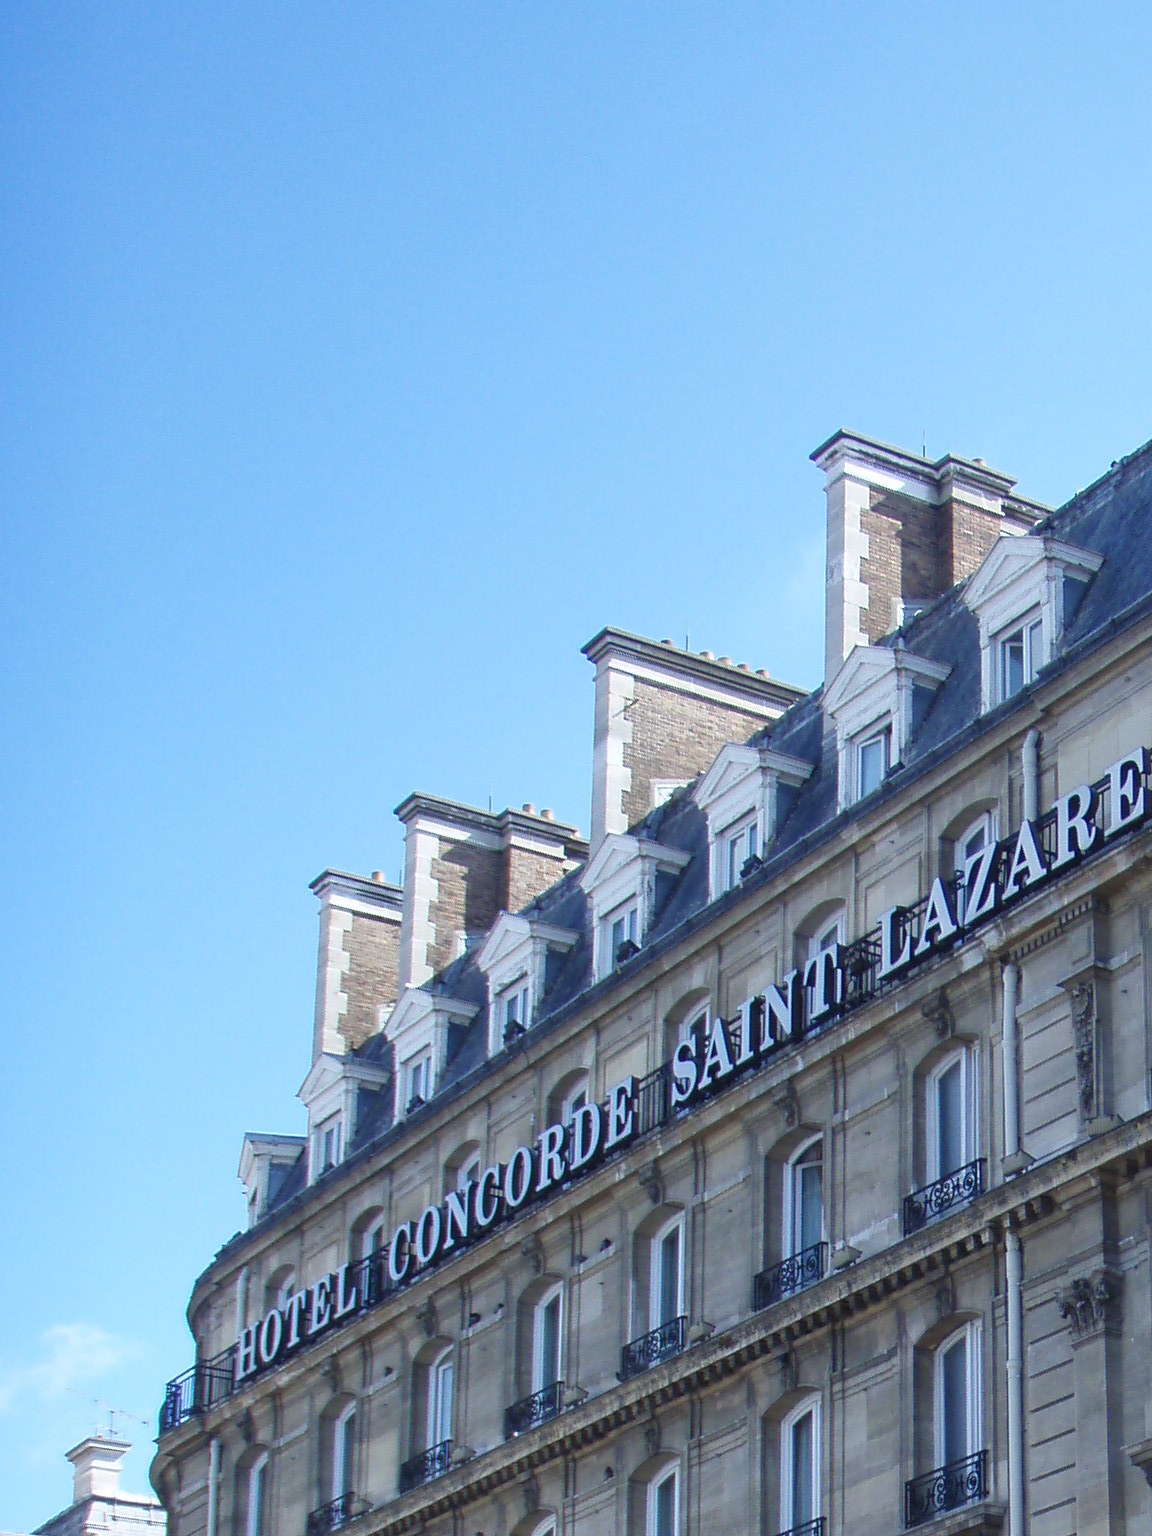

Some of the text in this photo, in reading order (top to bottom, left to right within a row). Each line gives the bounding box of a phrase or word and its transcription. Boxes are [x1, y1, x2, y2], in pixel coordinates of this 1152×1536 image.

[236, 746, 1149, 1382] HOTEL CONCORDE SAINT LAZARE
